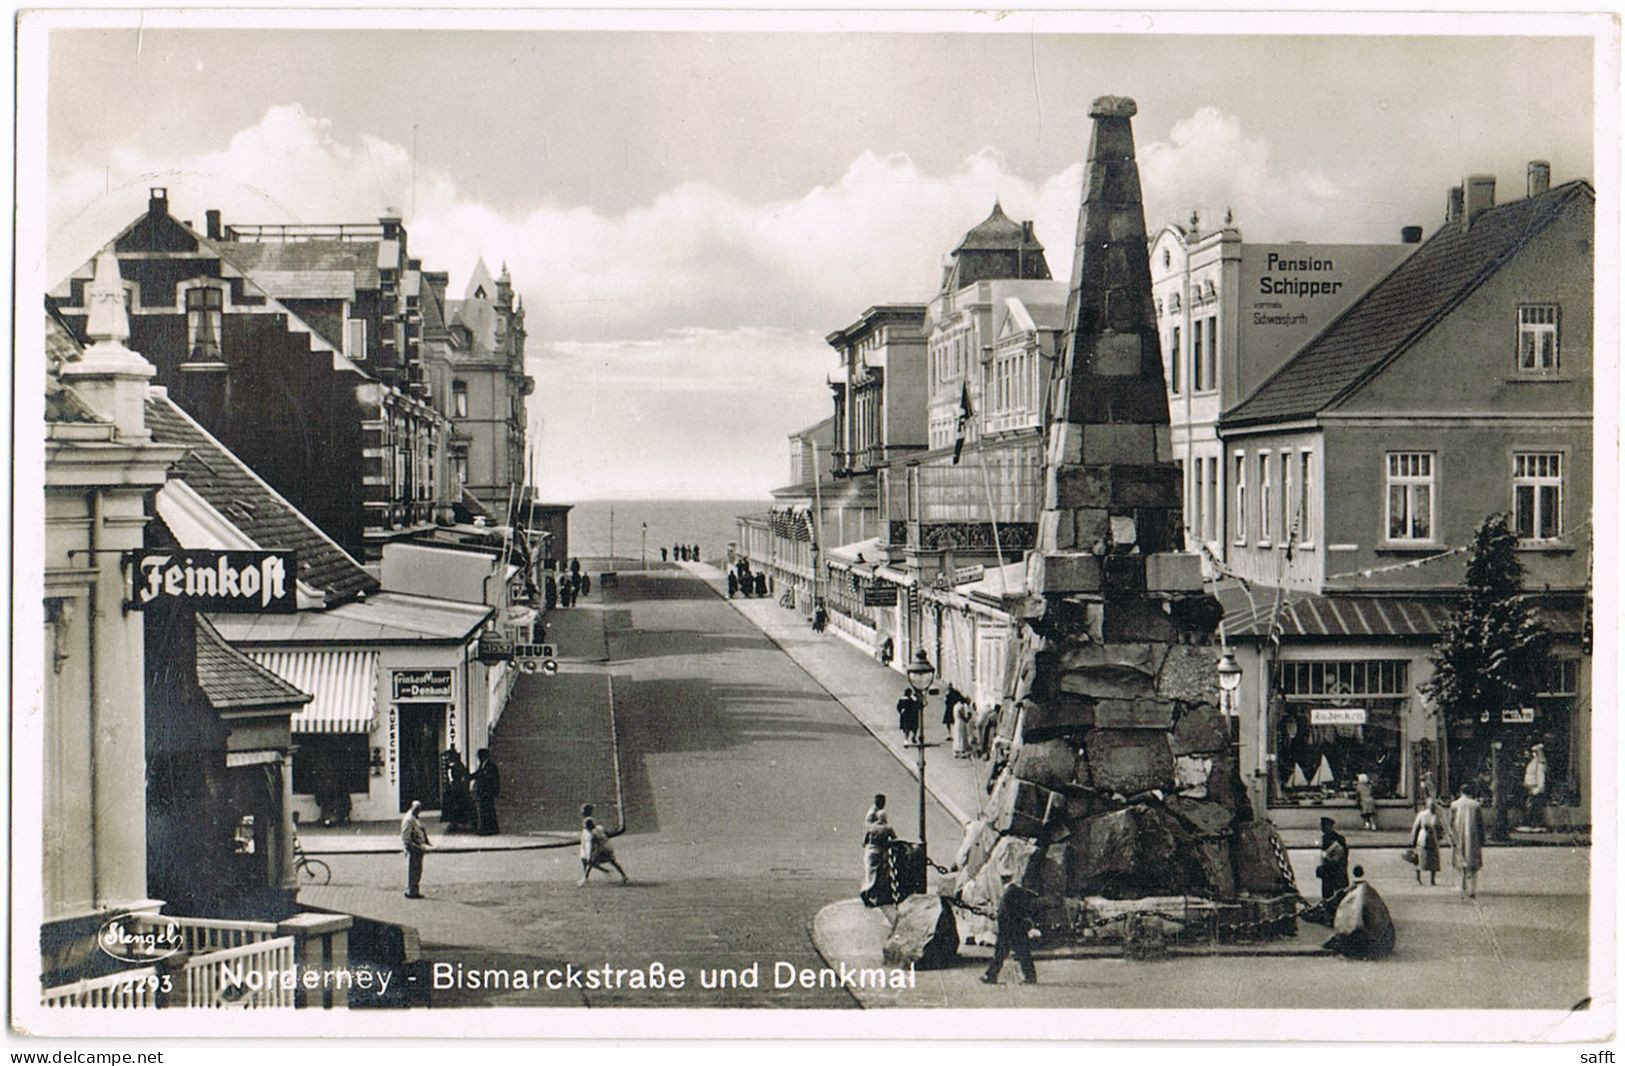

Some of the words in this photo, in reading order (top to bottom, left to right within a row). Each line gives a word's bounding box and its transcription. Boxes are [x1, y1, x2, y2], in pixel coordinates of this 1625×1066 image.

[1267, 252, 1333, 271] Pension
[1260, 276, 1343, 298] Schipper
[139, 555, 287, 608] Feinkost
